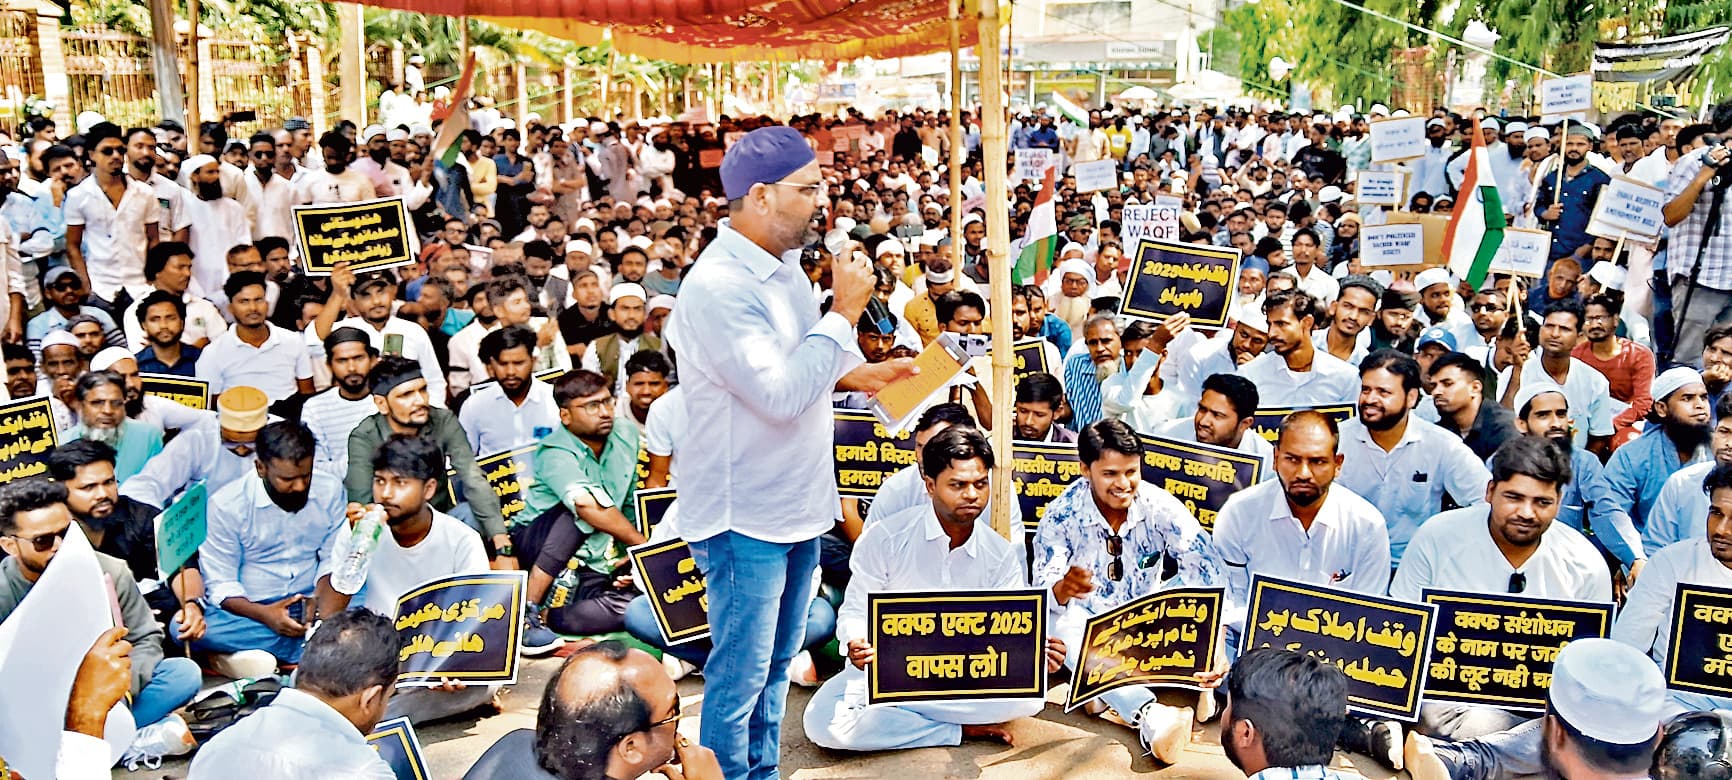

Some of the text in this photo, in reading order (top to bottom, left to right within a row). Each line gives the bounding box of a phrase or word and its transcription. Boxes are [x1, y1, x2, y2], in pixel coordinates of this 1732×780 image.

[1123, 207, 1178, 221] REJECT
[1128, 225, 1174, 239] WAQF
[0, 414, 23, 436] ایک
[835, 441, 917, 465] हमारी विरास
[1143, 450, 1183, 472] वक्फ
[839, 469, 882, 487] हमला
[1164, 477, 1209, 501] हमारा
[881, 611, 1033, 637] वक्फ एक्ट 2025
[1092, 598, 1208, 647] وقف ایکٹ کے
[1258, 608, 1417, 657] وقف املاک پر
[1454, 610, 1576, 638] वक्फ संशोधन
[1140, 628, 1164, 649] پر
[1163, 624, 1198, 648] نام
[1435, 631, 1459, 654] के
[1459, 638, 1500, 658] नाम
[1501, 642, 1530, 662] पर
[905, 654, 966, 679] वापस
[1099, 655, 1140, 684] چلے
[1140, 650, 1197, 672] نہیں
[1343, 656, 1408, 689] حملہ
[1429, 656, 1458, 681] की
[1459, 664, 1492, 692] लूट
[1492, 663, 1530, 689] नही
